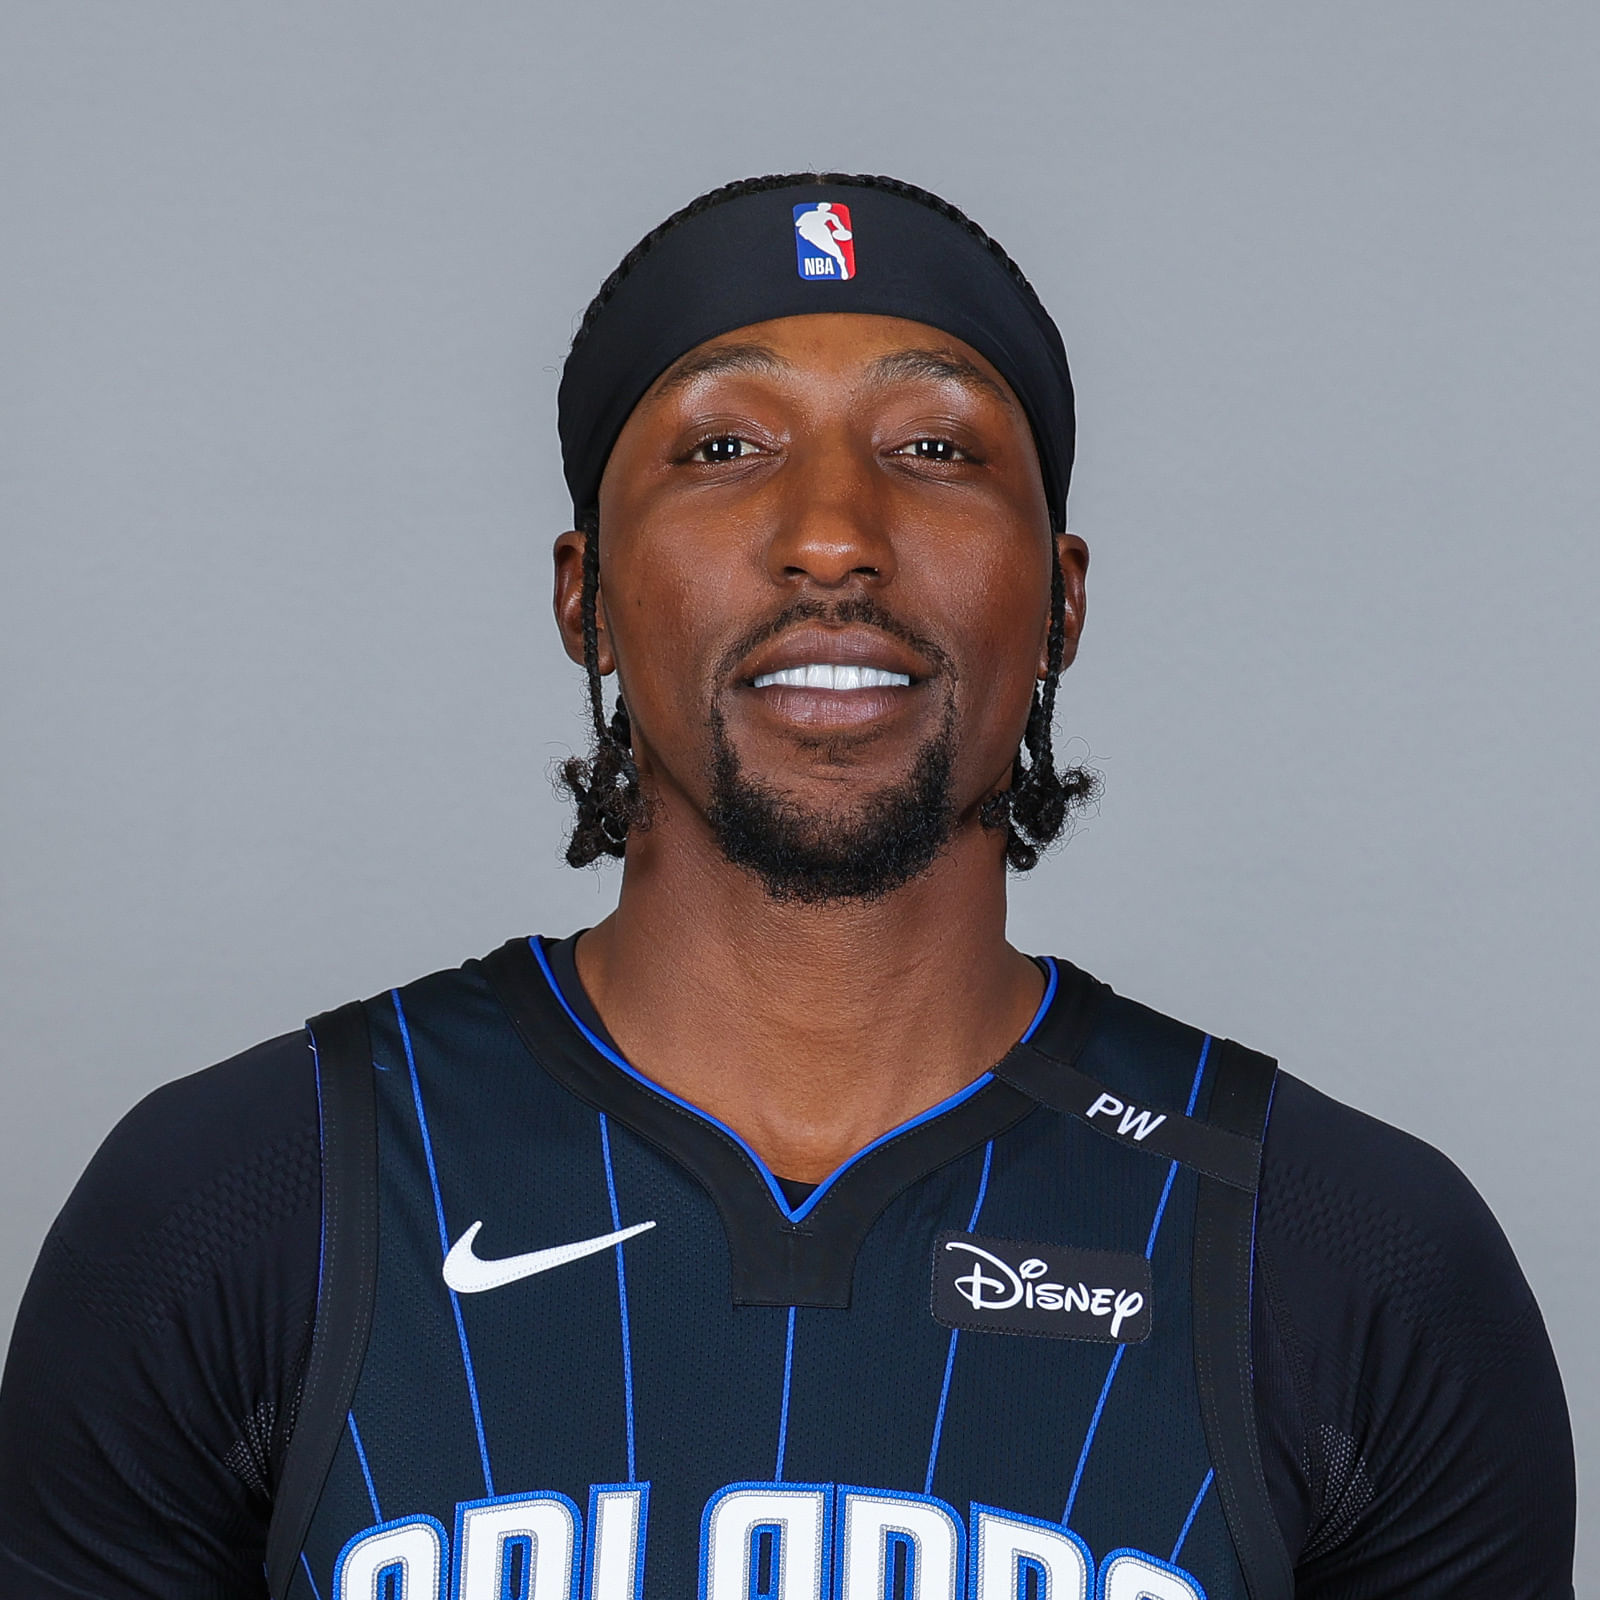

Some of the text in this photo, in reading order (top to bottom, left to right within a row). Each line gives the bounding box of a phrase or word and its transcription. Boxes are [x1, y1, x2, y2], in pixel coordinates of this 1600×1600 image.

[804, 257, 835, 276] NBA
[1086, 1092, 1168, 1141] PW
[945, 1241, 1144, 1338] Disney
